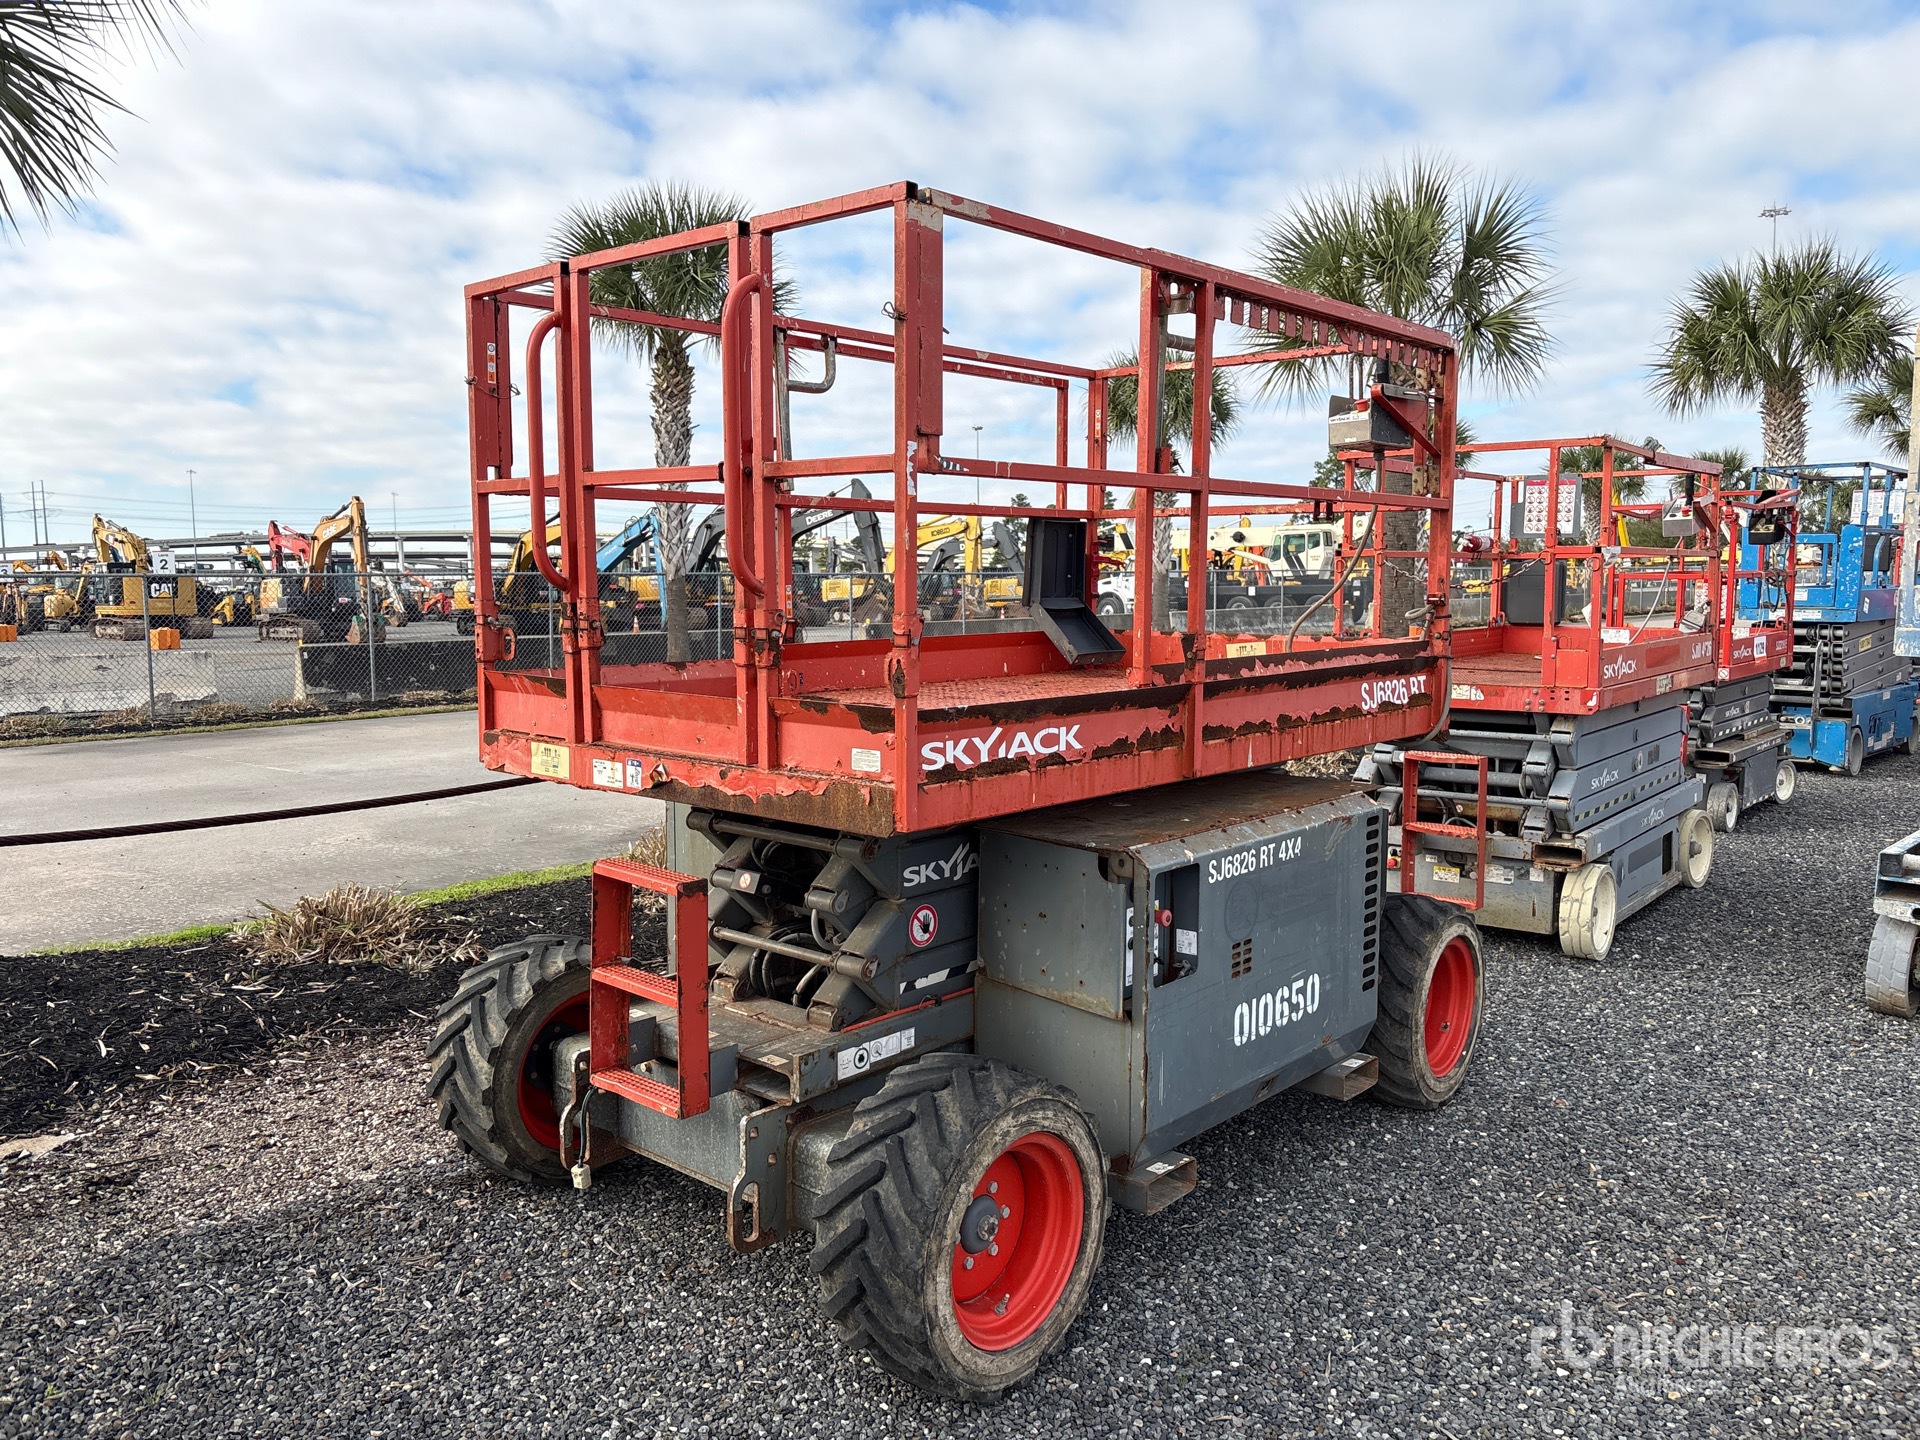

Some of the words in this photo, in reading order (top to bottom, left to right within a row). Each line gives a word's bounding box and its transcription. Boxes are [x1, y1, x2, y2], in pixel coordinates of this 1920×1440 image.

[806, 509, 833, 525] DEERE
[930, 526, 950, 537] KOBELCO
[159, 558, 169, 570] 2
[151, 582, 175, 599] CAT
[1603, 654, 1637, 680] SKYJACK
[1361, 678, 1409, 710] SJ6826
[1409, 675, 1427, 695] RT
[1591, 768, 1619, 790] SKYJACK
[1208, 847, 1257, 884] SJ6826
[1259, 842, 1276, 868] RT
[1278, 836, 1302, 862] 4X4
[1233, 972, 1320, 1047] 010650
